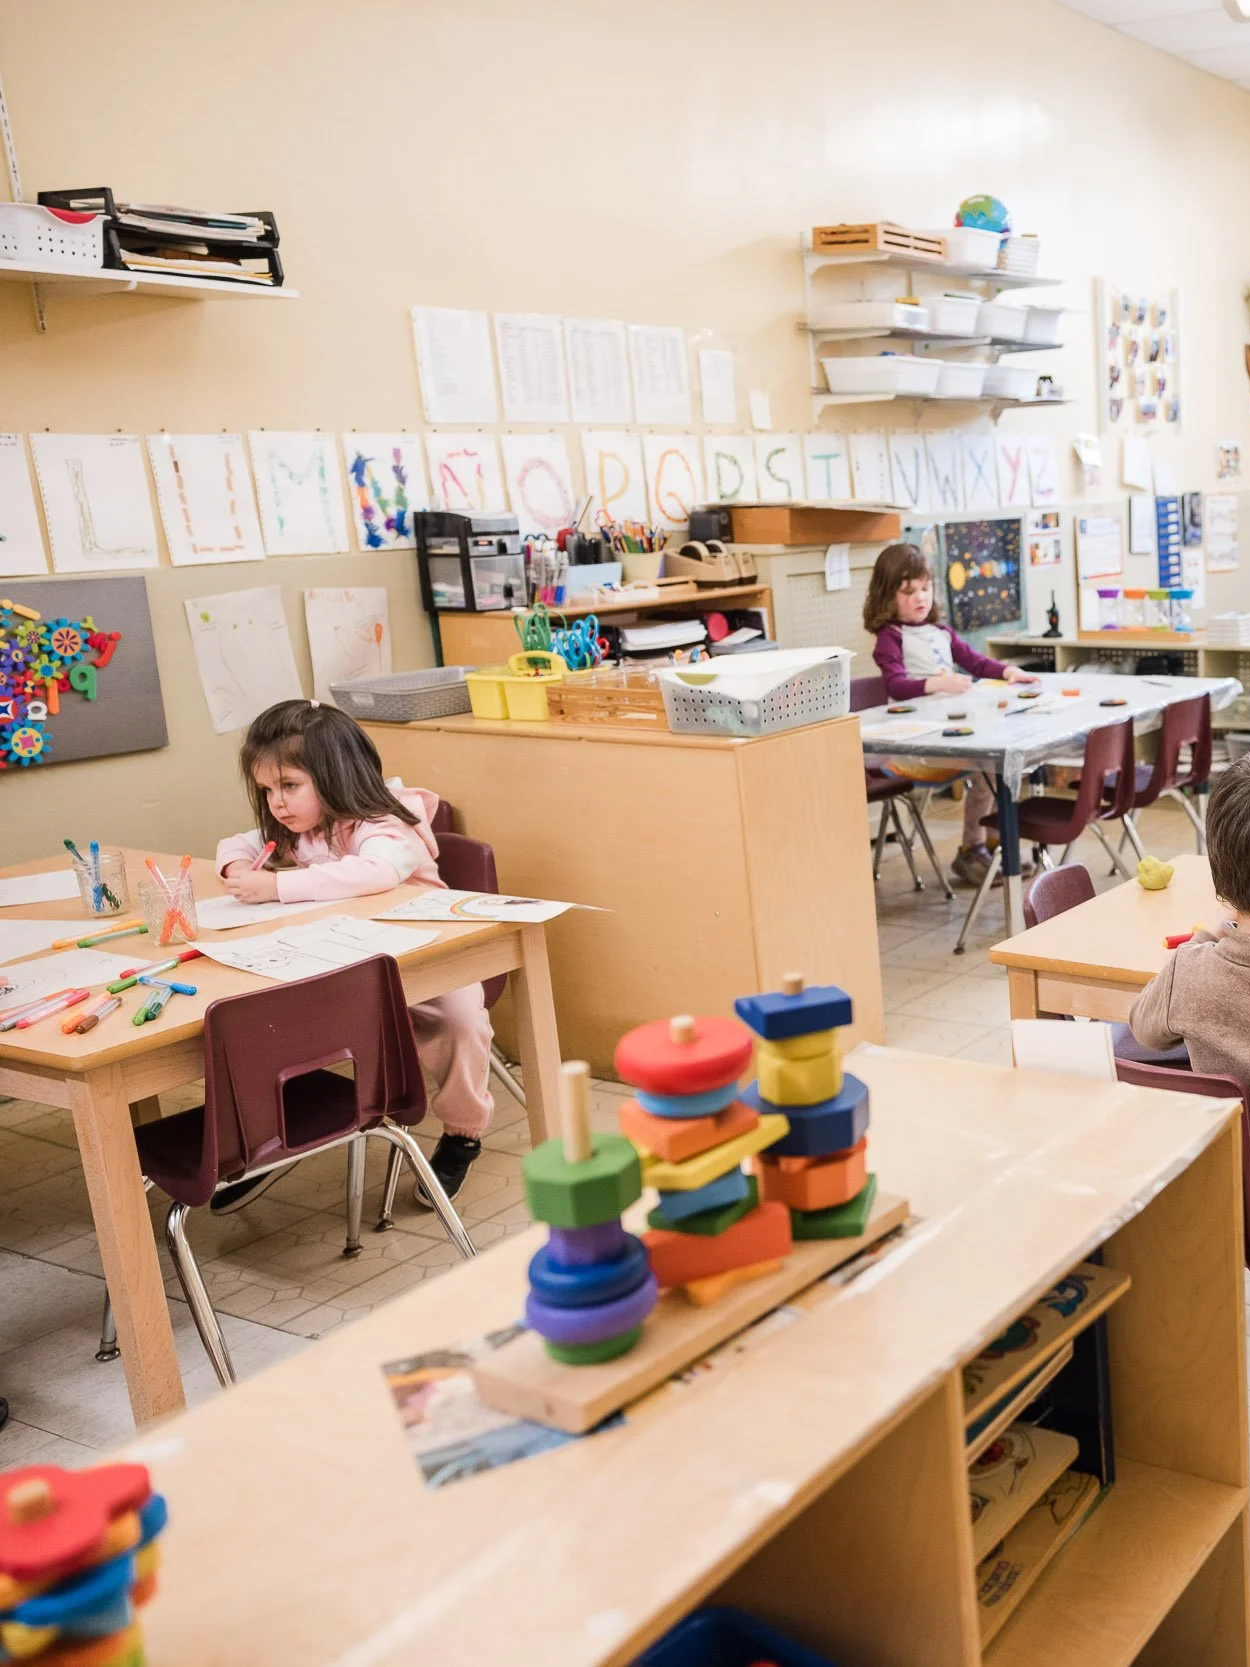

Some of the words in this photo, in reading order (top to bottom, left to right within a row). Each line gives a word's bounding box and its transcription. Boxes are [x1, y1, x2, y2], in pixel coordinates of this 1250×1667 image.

[266, 447, 336, 546] M
[350, 447, 411, 549] N
[516, 457, 571, 529] O
[599, 449, 630, 514] P
[655, 448, 697, 524] Q
[811, 453, 841, 500] T
[967, 447, 995, 501] X
[1001, 444, 1021, 502] Y
